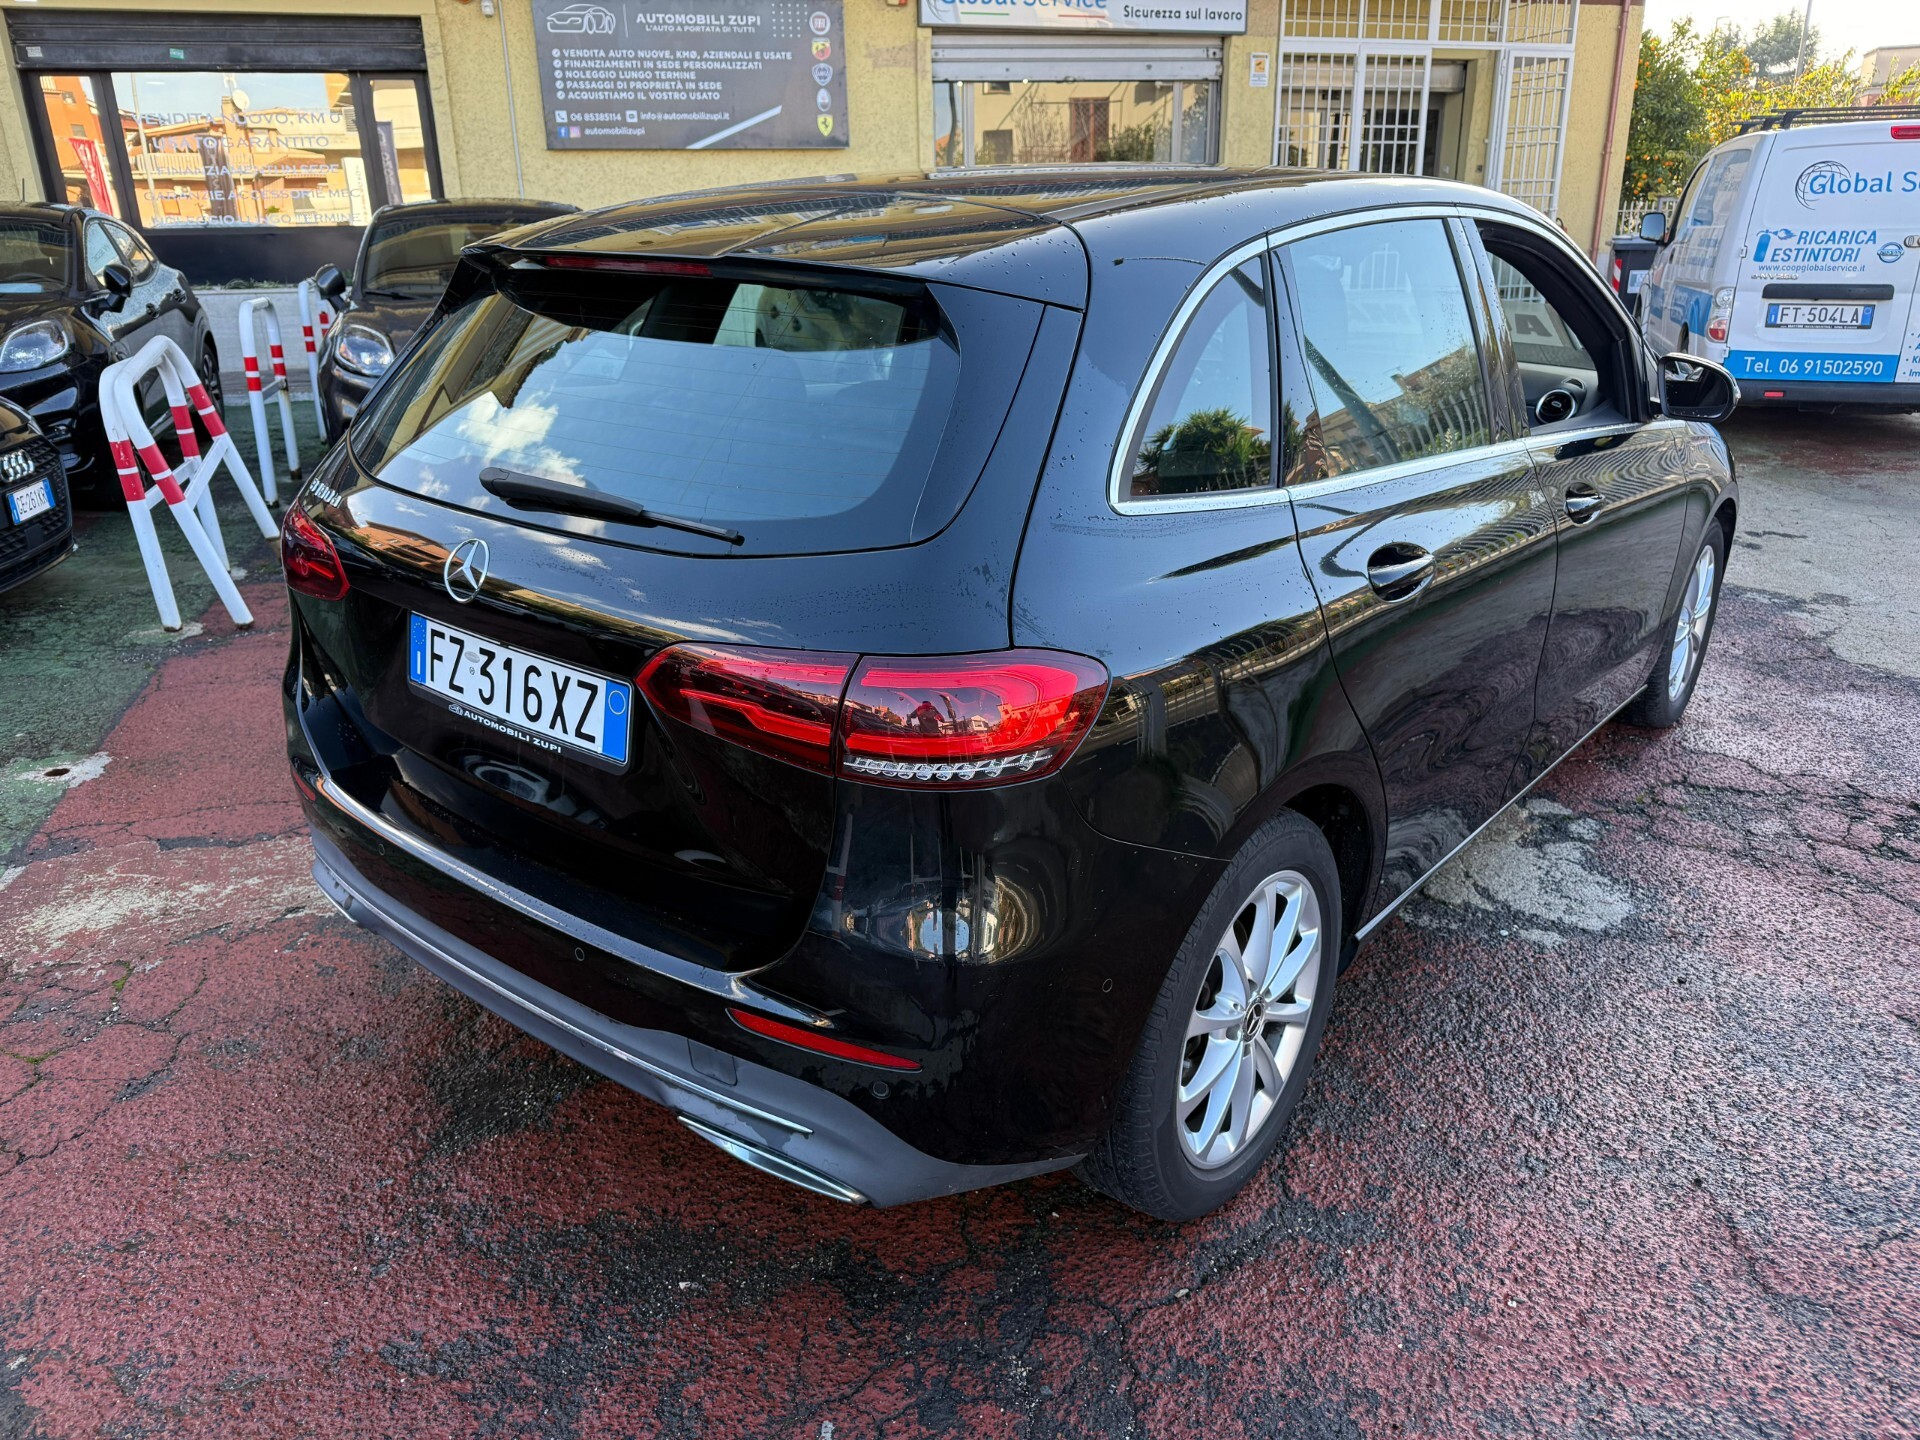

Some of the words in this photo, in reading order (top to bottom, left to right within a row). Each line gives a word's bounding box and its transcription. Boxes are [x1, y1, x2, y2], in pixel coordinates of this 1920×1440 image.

[1123, 5, 1181, 19] Sicurezza
[1185, 8, 1201, 20] sul
[1205, 8, 1243, 20] lavoro
[636, 13, 725, 25] AUTOMOBILI
[727, 15, 761, 26] ZUPI
[563, 49, 606, 57] VENDITA
[608, 49, 635, 58] AUTO
[638, 50, 674, 59] NUOVE,
[703, 51, 752, 59] AZIENDALI
[754, 51, 761, 59] E
[763, 51, 792, 60] USATE
[564, 59, 641, 68] FINANZIAMENTI
[656, 61, 681, 69] SEDE
[683, 61, 762, 70] PERSONALIZZATI
[565, 70, 616, 79] NOLEGGIO
[619, 71, 652, 79] LUNGO
[654, 71, 696, 79] TERMINE
[566, 81, 614, 89] PASSAGGI
[617, 81, 627, 89] DI
[629, 80, 683, 89] PROPRIETÀ
[698, 82, 722, 90] SEDE
[568, 91, 635, 100] ACQUISTIAMO
[637, 92, 646, 100] IL
[649, 92, 687, 100] VOSTRO
[689, 92, 720, 100] USATO
[132, 112, 216, 125] VENDITA
[222, 112, 294, 125] NUOVO,
[298, 112, 325, 124] KM
[330, 112, 341, 124] 0
[570, 112, 583, 121] 06
[640, 111, 730, 121] info@automobilizupi.it
[584, 126, 645, 136] automobilizupi
[151, 136, 218, 149] USATO
[222, 136, 329, 149] GARANTITO
[157, 164, 279, 176] FINANZIAMENTI
[299, 163, 340, 174] SEDE
[1810, 171, 1893, 195] Global
[1901, 171, 1920, 193] S
[144, 190, 225, 201] GARANZIE
[228, 189, 326, 200] ACCESSORIE
[152, 214, 235, 225] NOLEGGIO
[237, 213, 292, 225] LUNGO
[295, 212, 361, 224] TERMINE
[1796, 230, 1877, 245] RICARICA
[1770, 247, 1861, 262] ESTINTORI
[1758, 264, 1866, 273] www.coopglobalservice.it
[1744, 356, 1773, 374] Tel.
[1779, 358, 1799, 374] 06
[1804, 359, 1883, 376] 91502590
[464, 710, 530, 742] AUTOMOBILI
[532, 737, 562, 754] ZUPI
